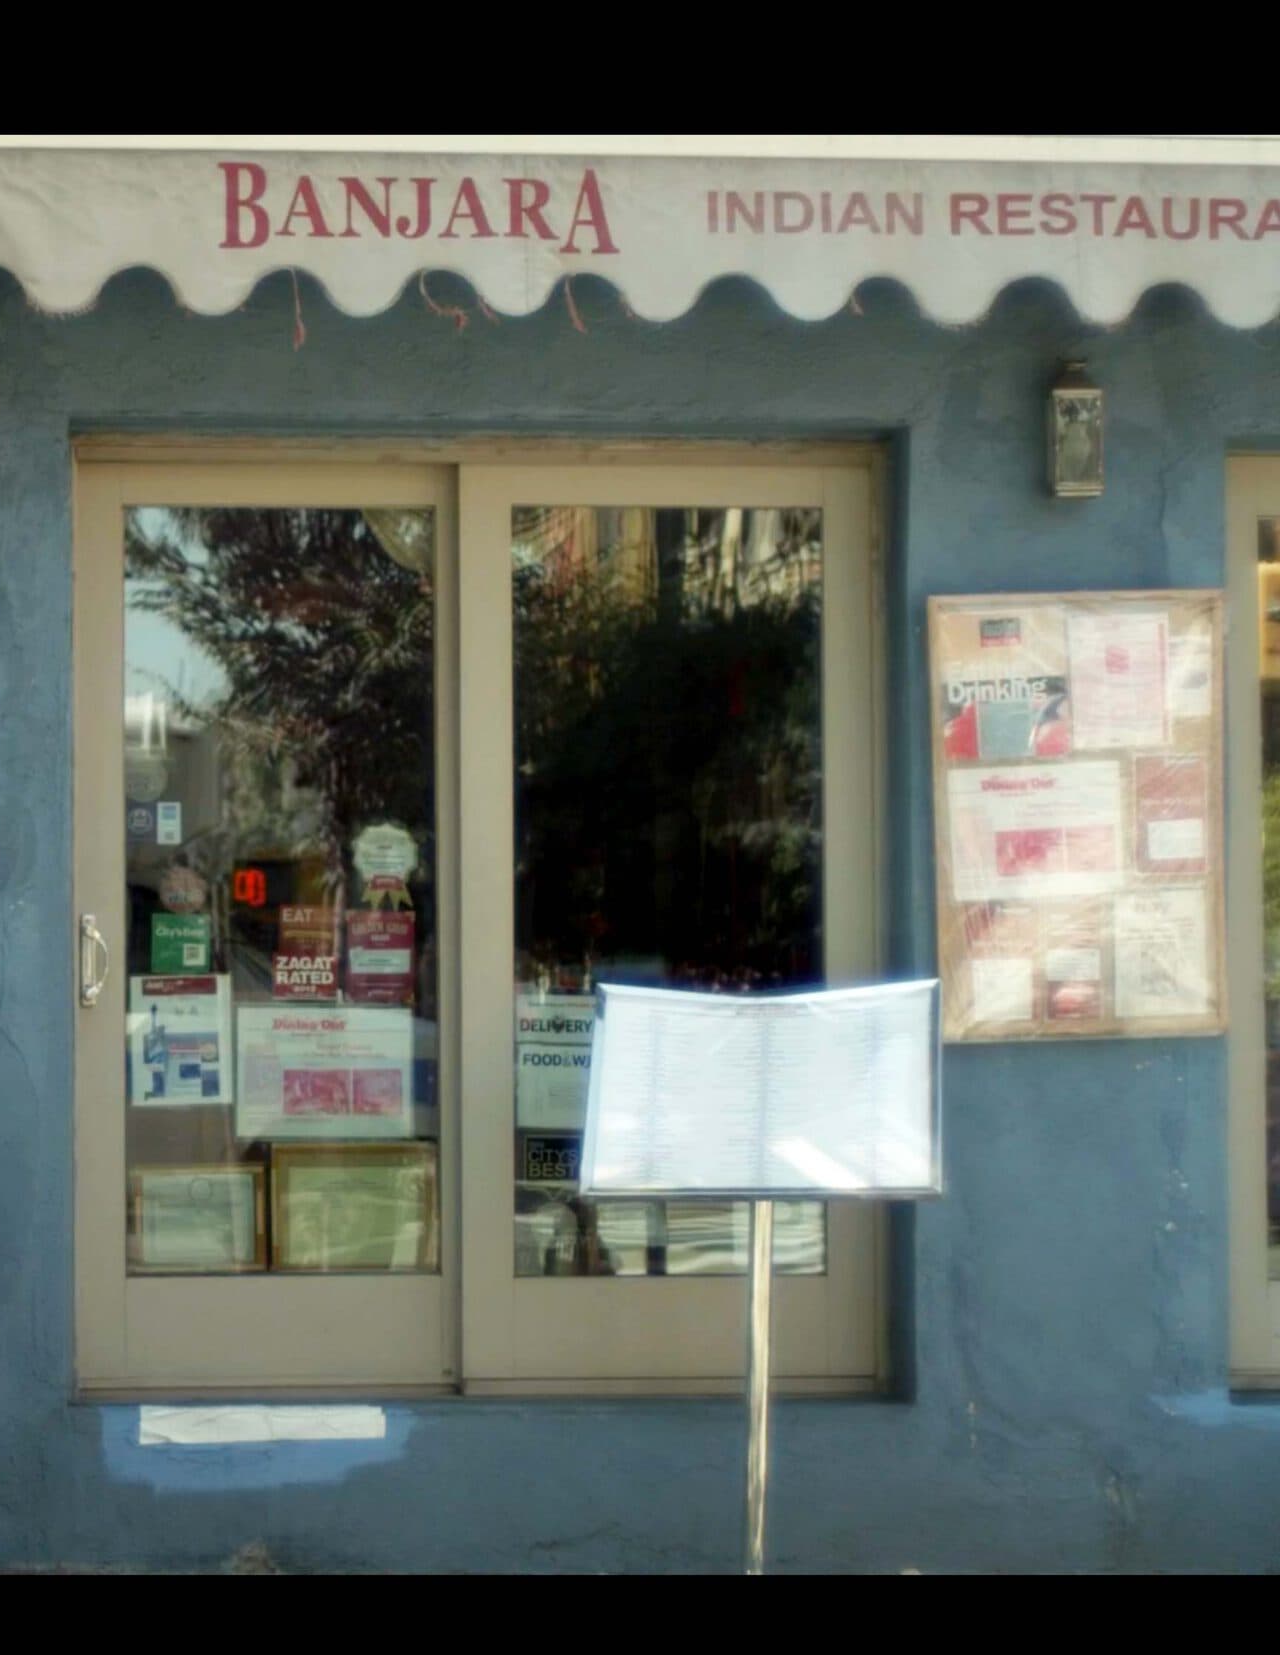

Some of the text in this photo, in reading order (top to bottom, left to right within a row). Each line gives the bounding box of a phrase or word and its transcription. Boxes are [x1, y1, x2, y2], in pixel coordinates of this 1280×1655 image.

[217, 161, 621, 255] BANJARA
[706, 191, 924, 235] INDIAN
[947, 675, 1048, 705] Drinking
[282, 907, 313, 923] EAT
[276, 956, 335, 970] ZAGAT
[276, 971, 334, 985] RATED
